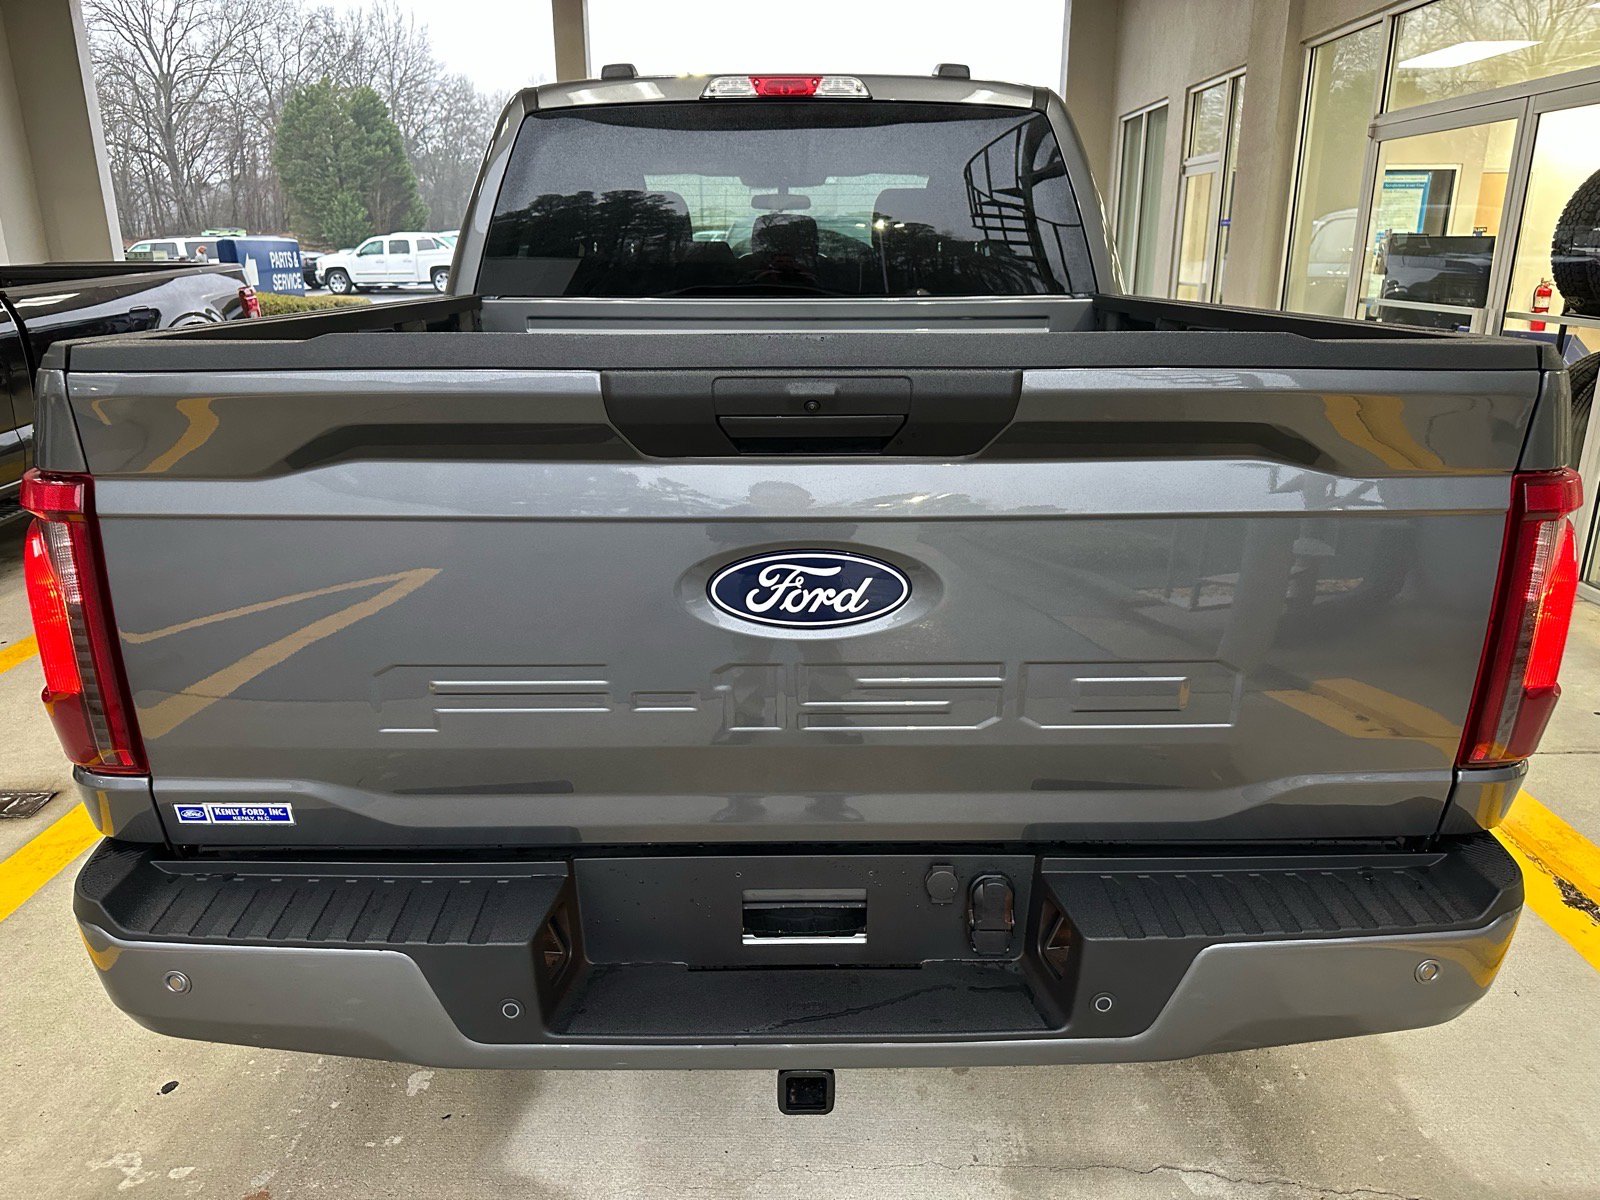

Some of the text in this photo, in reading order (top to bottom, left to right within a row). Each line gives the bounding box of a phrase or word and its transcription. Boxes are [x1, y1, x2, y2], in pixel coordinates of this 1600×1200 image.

[269, 251, 299, 268] PARTS &
[272, 272, 302, 291] SERVICE
[745, 563, 873, 613] Ford
[373, 663, 1242, 732] F-150
[182, 810, 203, 818] Ford
[213, 807, 287, 817] KENLY FORD, INC.
